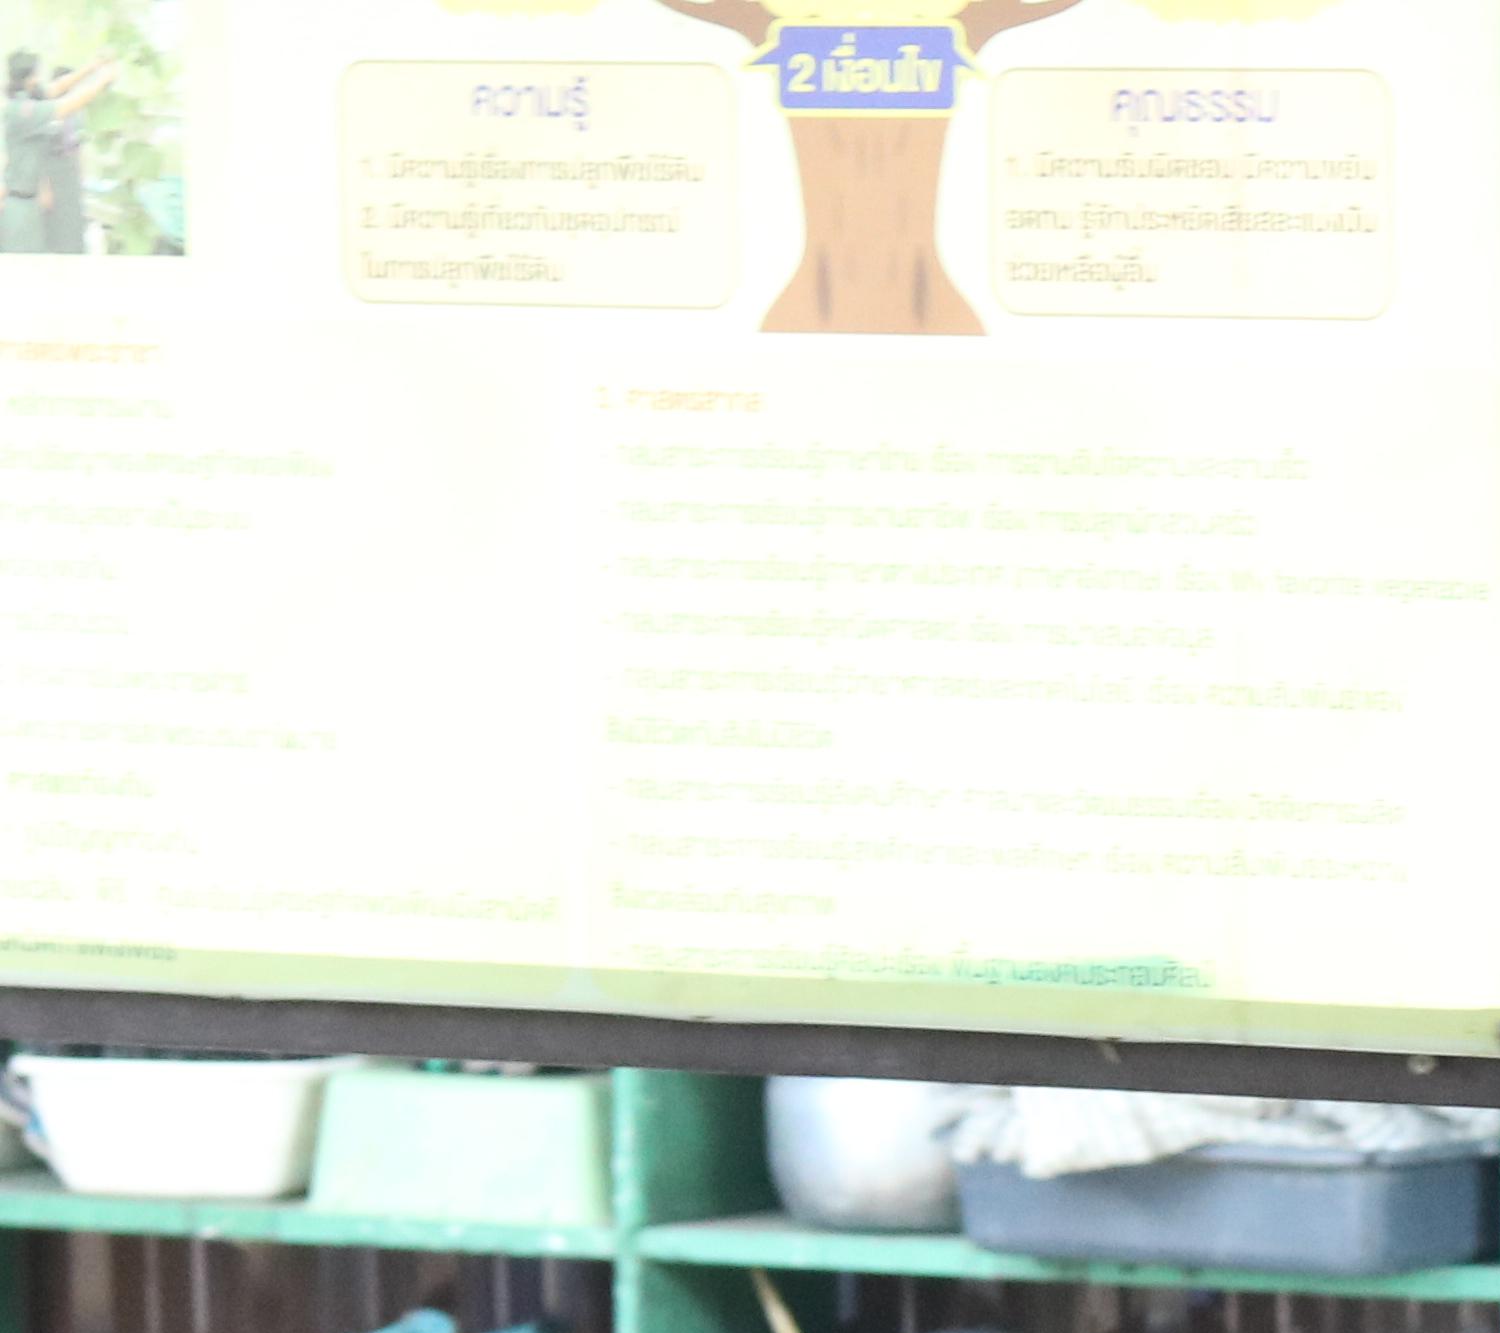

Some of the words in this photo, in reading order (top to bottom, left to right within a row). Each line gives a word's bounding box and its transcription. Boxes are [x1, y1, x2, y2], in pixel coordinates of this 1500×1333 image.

[787, 53, 817, 92] 2
[471, 75, 590, 132] ความรู้
[1110, 88, 1280, 138] คุณธรรม
